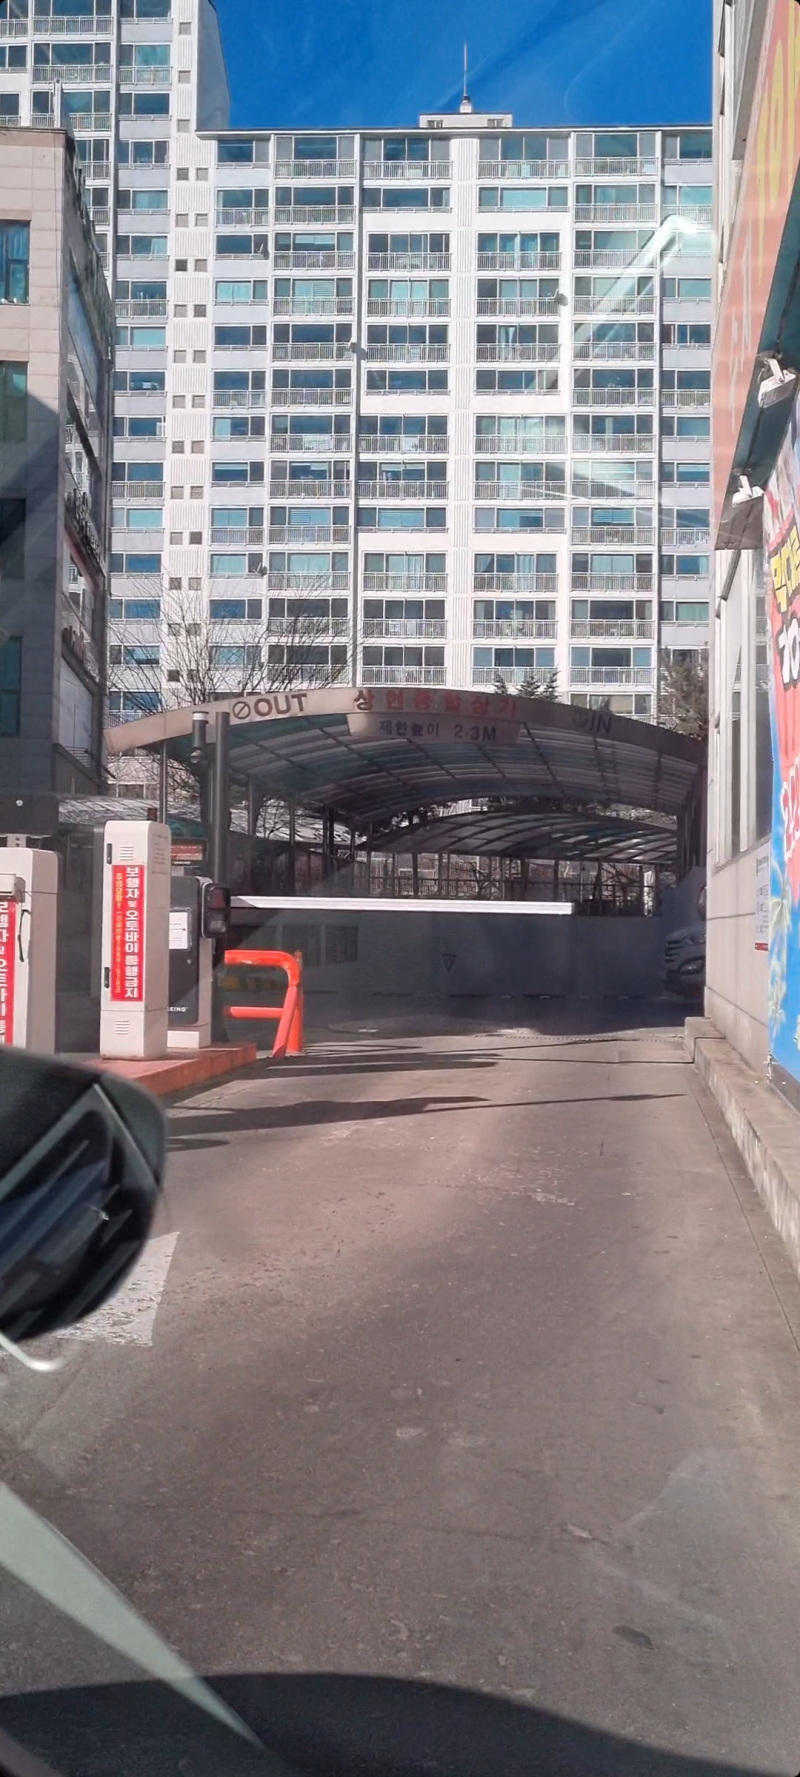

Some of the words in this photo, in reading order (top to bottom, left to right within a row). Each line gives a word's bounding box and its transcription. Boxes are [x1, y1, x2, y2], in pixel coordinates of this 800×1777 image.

[254, 693, 307, 717] OUT
[379, 720, 439, 737] 제한높이
[454, 724, 497, 742] 2.3M
[589, 711, 612, 735] IN
[125, 866, 140, 898] 보행자
[127, 900, 138, 908] 및
[124, 909, 139, 953] 오토바이
[124, 954, 139, 998] 통행금지
